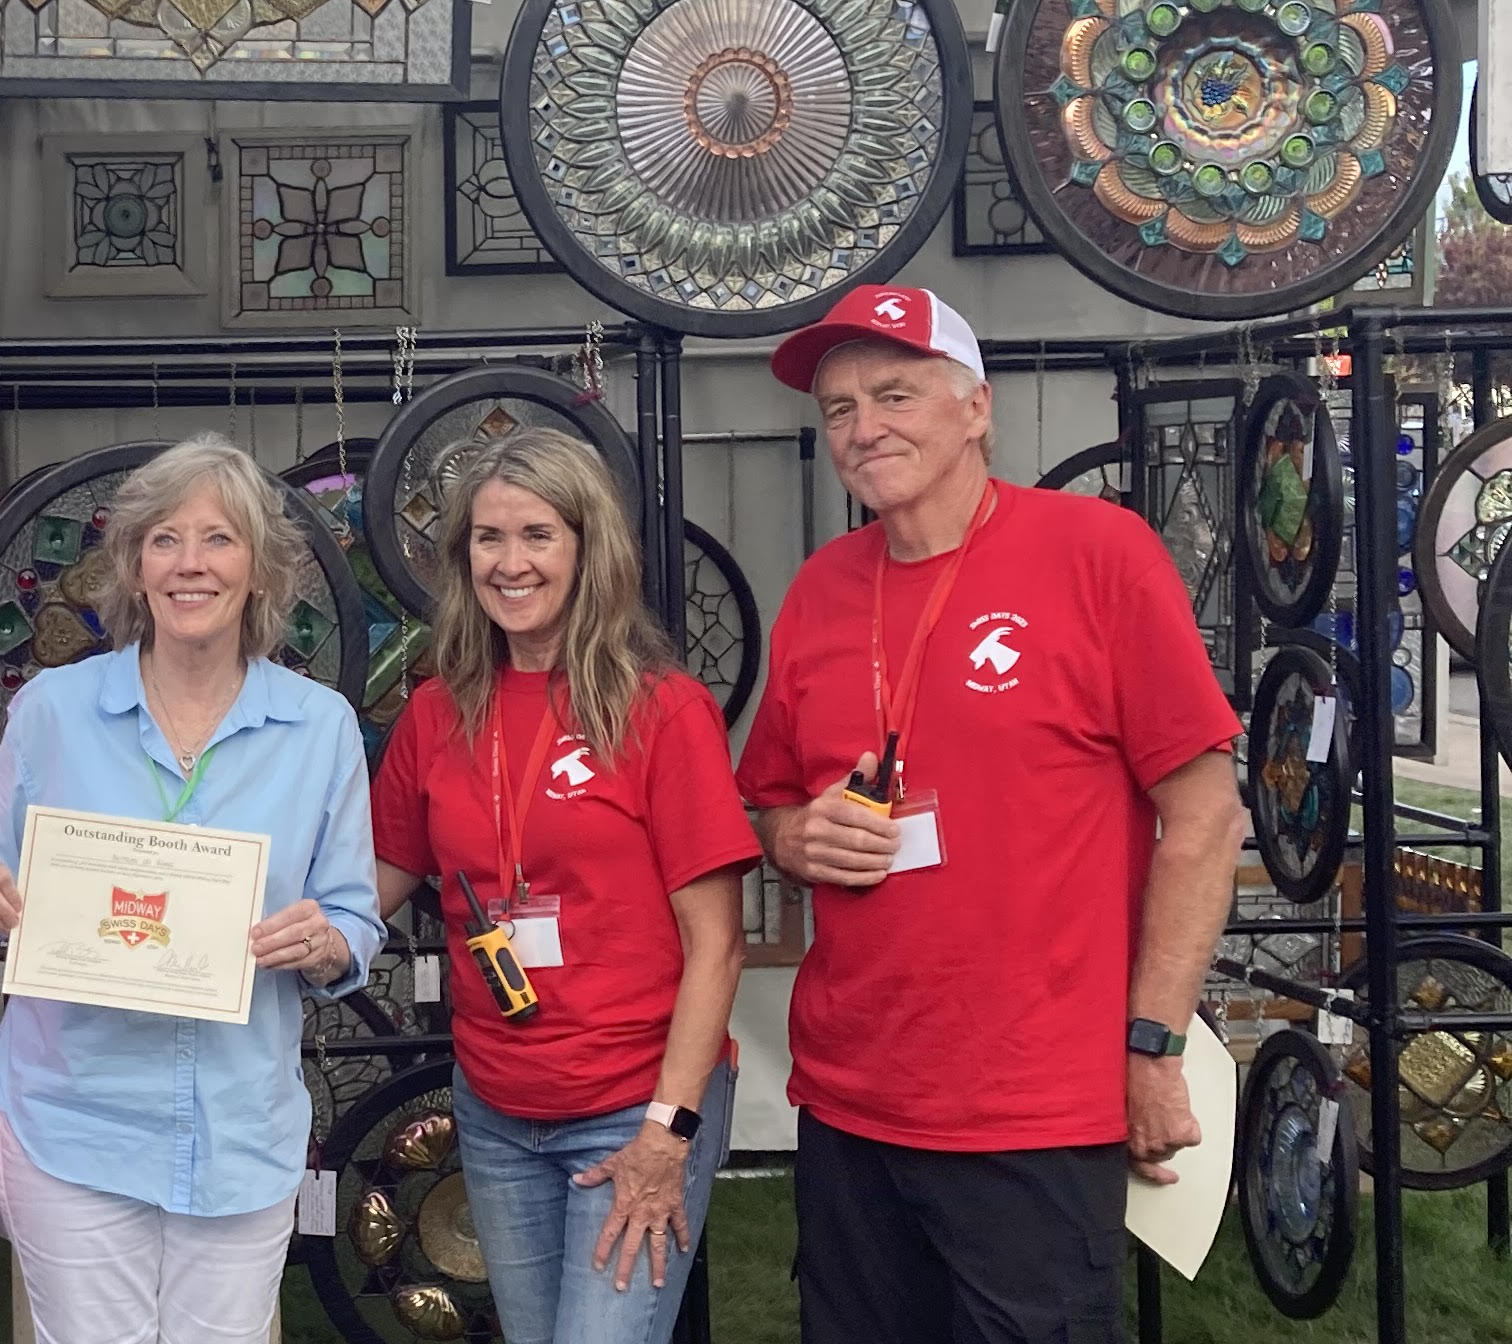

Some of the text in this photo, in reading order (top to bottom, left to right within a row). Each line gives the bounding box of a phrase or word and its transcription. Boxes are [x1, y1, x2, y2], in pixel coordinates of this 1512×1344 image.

[64, 825, 145, 848] Outstanding
[149, 836, 188, 852] Booth
[192, 842, 232, 857] Award
[113, 899, 162, 918] MIDWAY
[103, 918, 168, 938] SWISS DAYS
